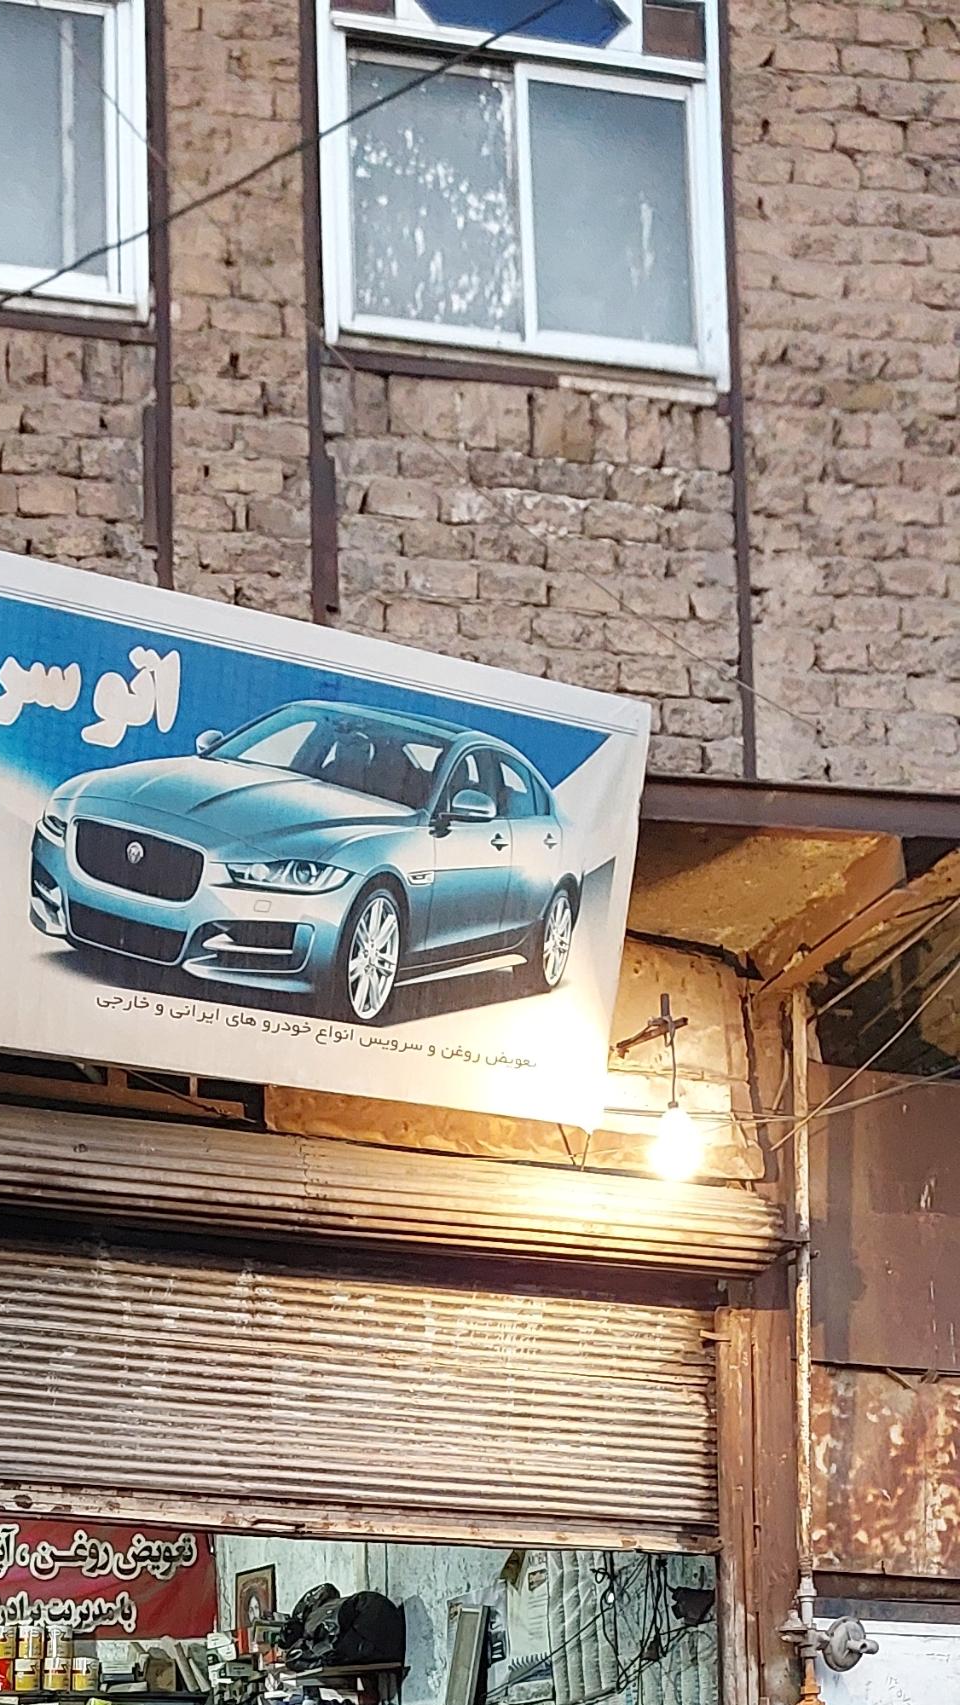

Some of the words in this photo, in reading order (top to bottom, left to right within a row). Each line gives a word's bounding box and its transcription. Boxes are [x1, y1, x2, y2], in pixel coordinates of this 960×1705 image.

[81, 647, 181, 748] اتو
[96, 994, 150, 1012] خارجی
[154, 1002, 164, 1015] و
[169, 1004, 220, 1024] ایرانی
[225, 1012, 257, 1027] های
[262, 1019, 312, 1036] خودرو
[315, 1025, 354, 1045] انواع
[359, 1035, 423, 1052] سرویس
[427, 1043, 436, 1057] و
[441, 1045, 481, 1063] روغن
[115, 1532, 196, 1580] تعویض
